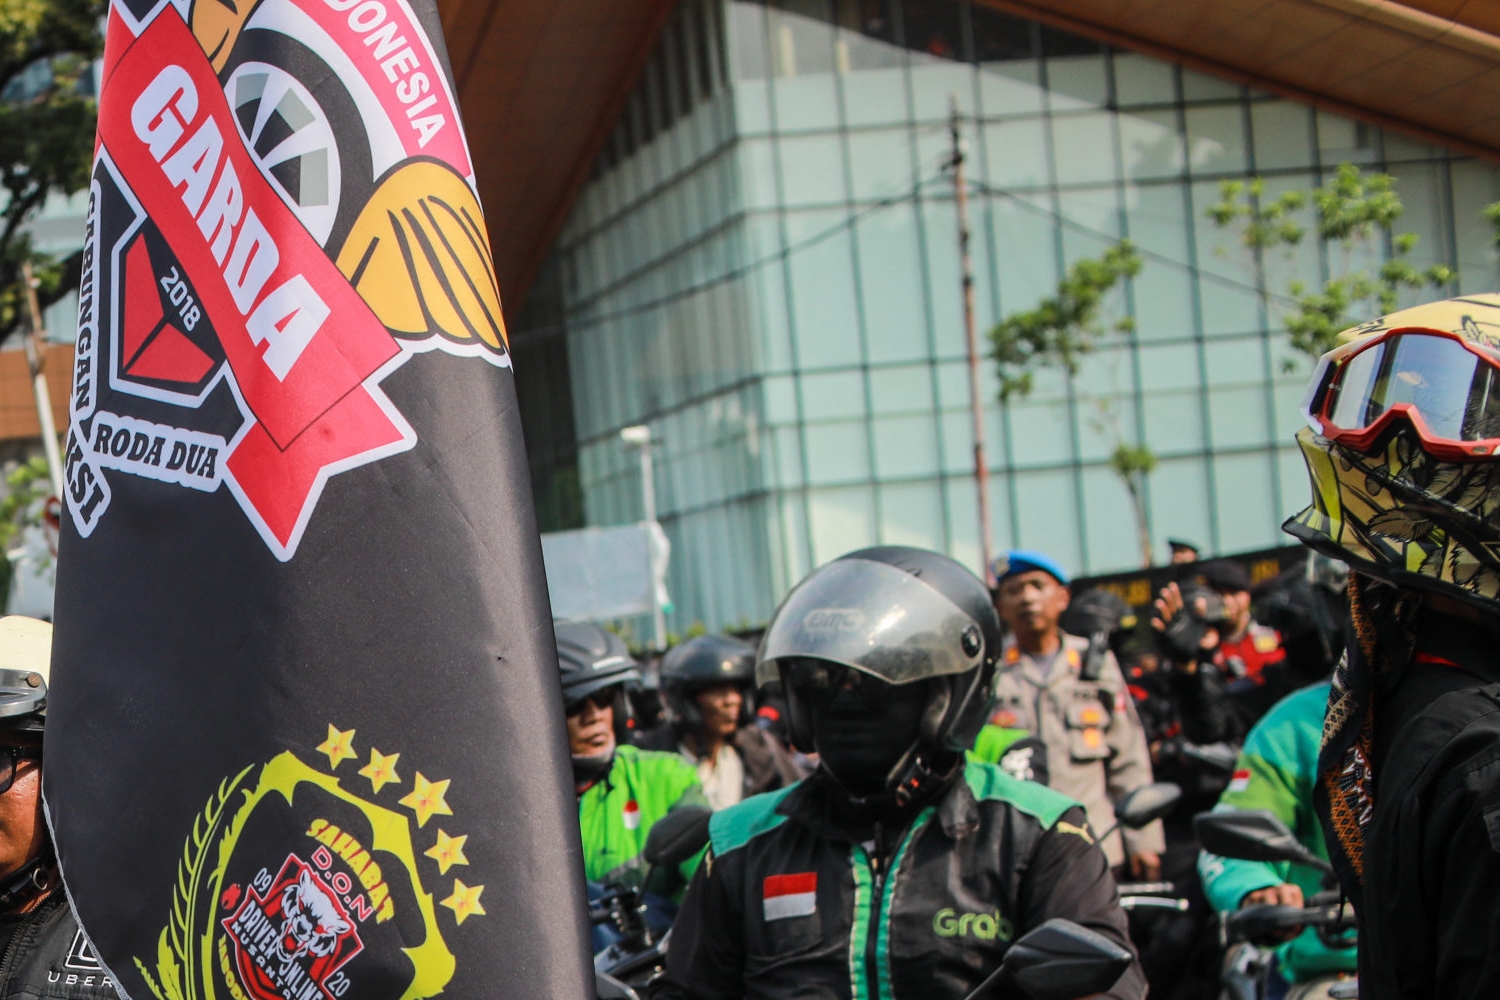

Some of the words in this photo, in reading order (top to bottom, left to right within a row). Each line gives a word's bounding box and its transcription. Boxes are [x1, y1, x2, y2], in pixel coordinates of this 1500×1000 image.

[131, 65, 331, 383] GARDA
[160, 266, 201, 332] 2018
[93, 423, 165, 468] RODA
[166, 441, 219, 480] DUA
[253, 867, 273, 892] 09
[305, 818, 395, 924] SAHABAT
[311, 845, 374, 922] D.O.N
[238, 900, 281, 960] DRIVER
[932, 907, 1013, 941] Grab
[47, 970, 113, 988] UBER
[328, 971, 351, 997] 20
